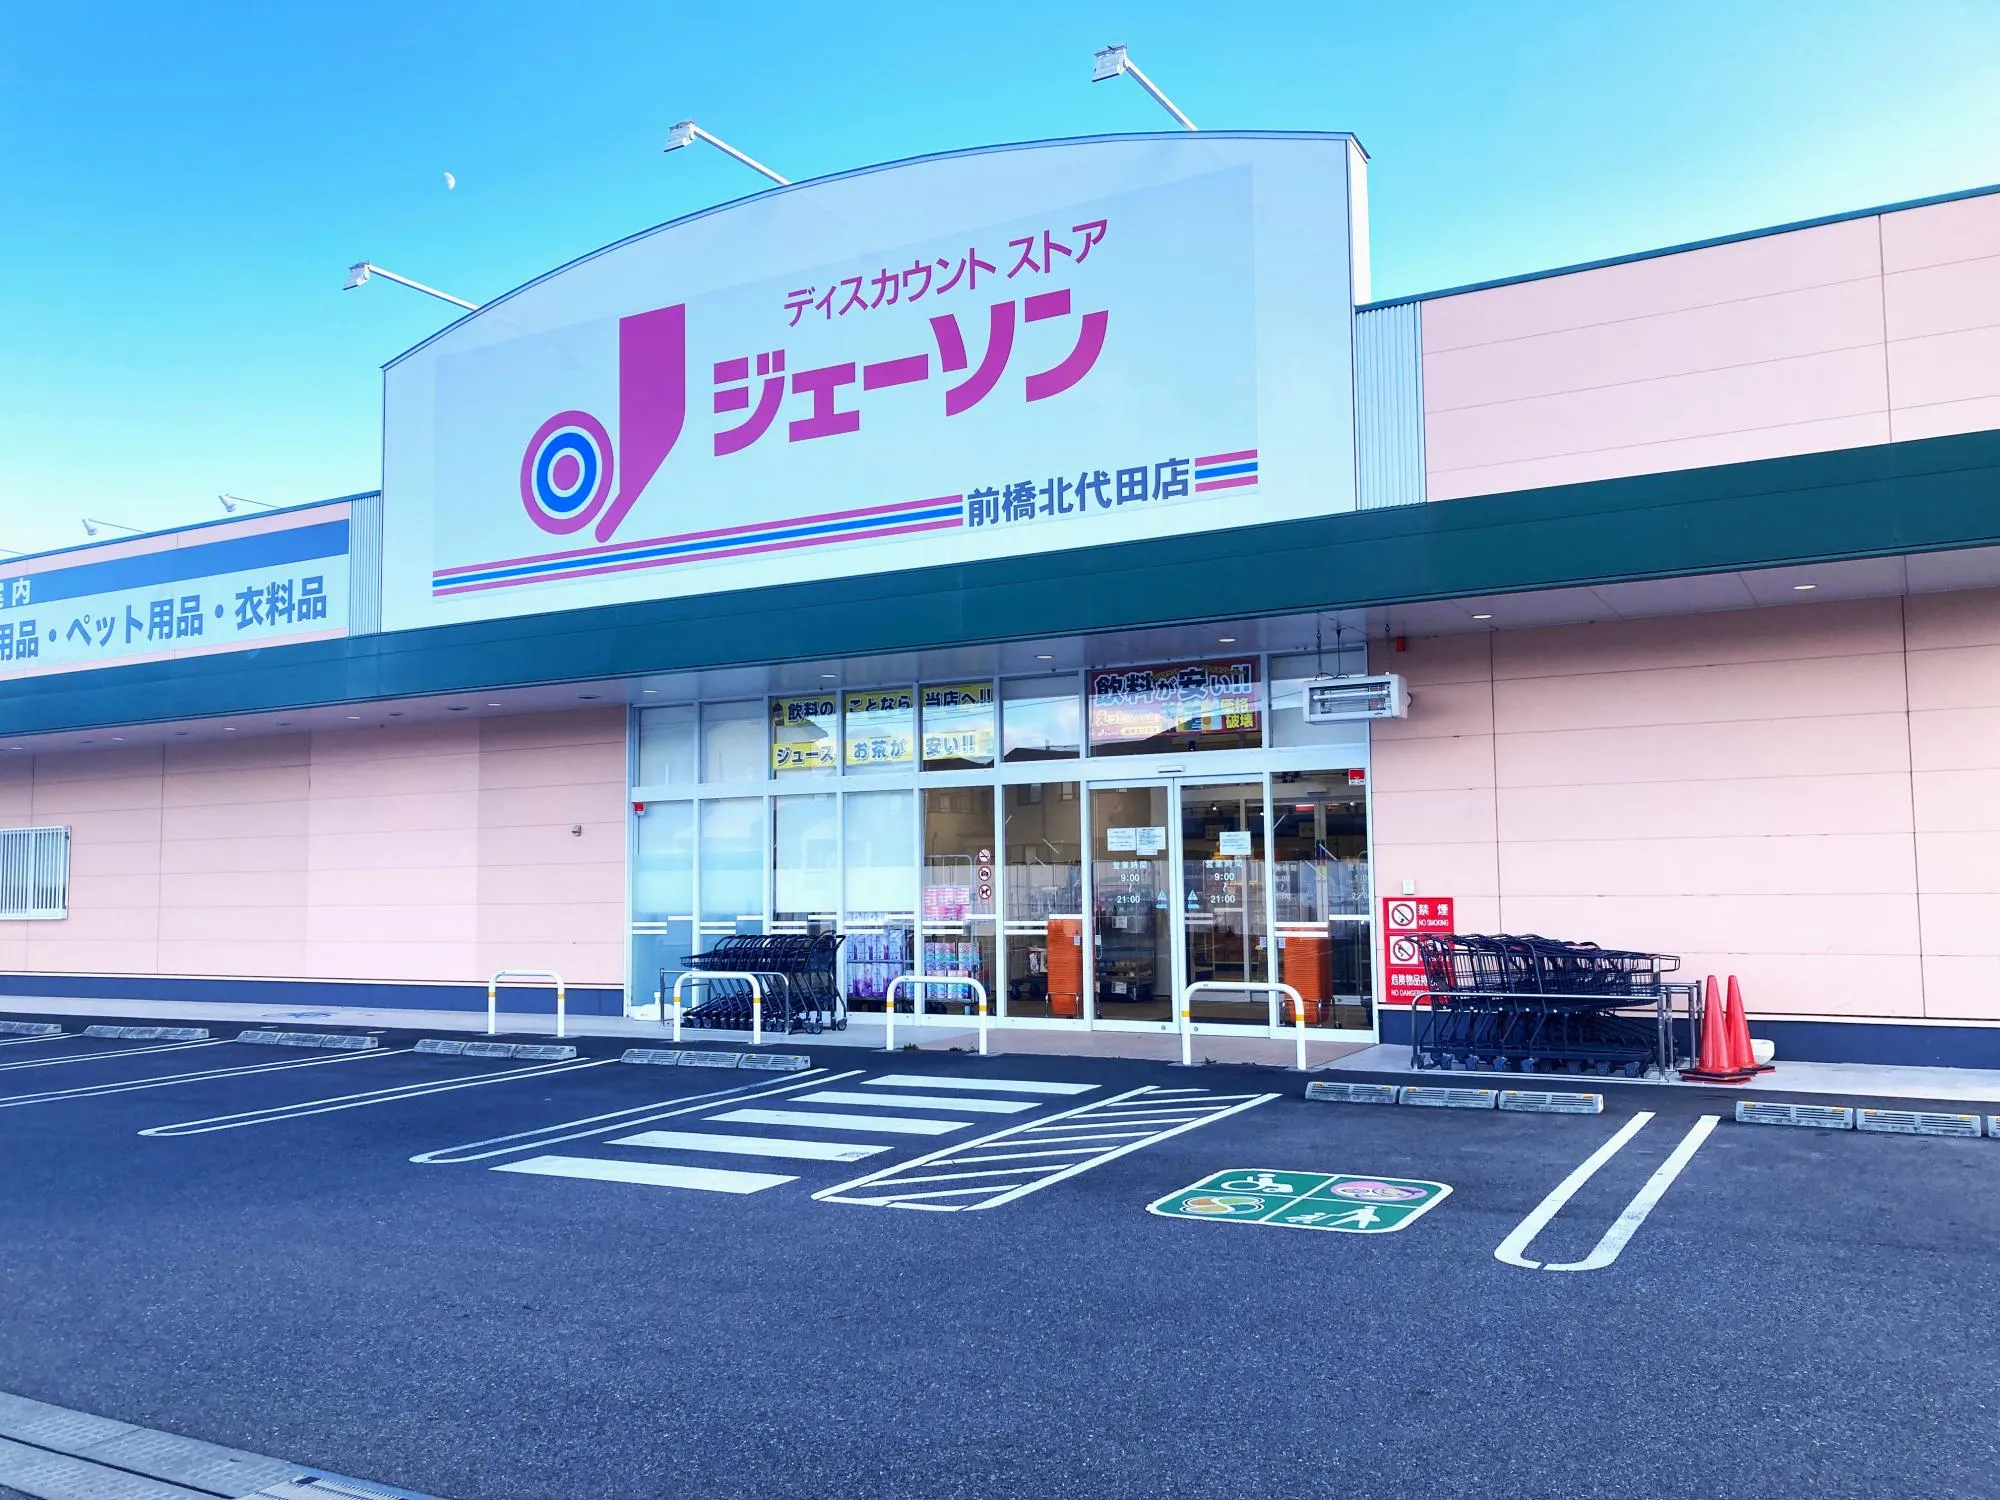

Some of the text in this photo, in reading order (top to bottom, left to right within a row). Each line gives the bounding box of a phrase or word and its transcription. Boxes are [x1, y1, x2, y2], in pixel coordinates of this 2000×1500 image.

[785, 219, 1108, 328] ディスカウント ストア
[713, 288, 1110, 458] ジェーソン
[967, 456, 1191, 529] 前橋北代田店
[0, 577, 31, 609] 内
[776, 745, 836, 766] ジュース
[853, 737, 907, 761] お茶が
[1120, 873, 1140, 882] 9:00
[1214, 872, 1235, 881] 9:00
[1116, 895, 1141, 904] 21:00
[1210, 894, 1236, 904] 21:00
[1427, 919, 1449, 927] SMOKING
